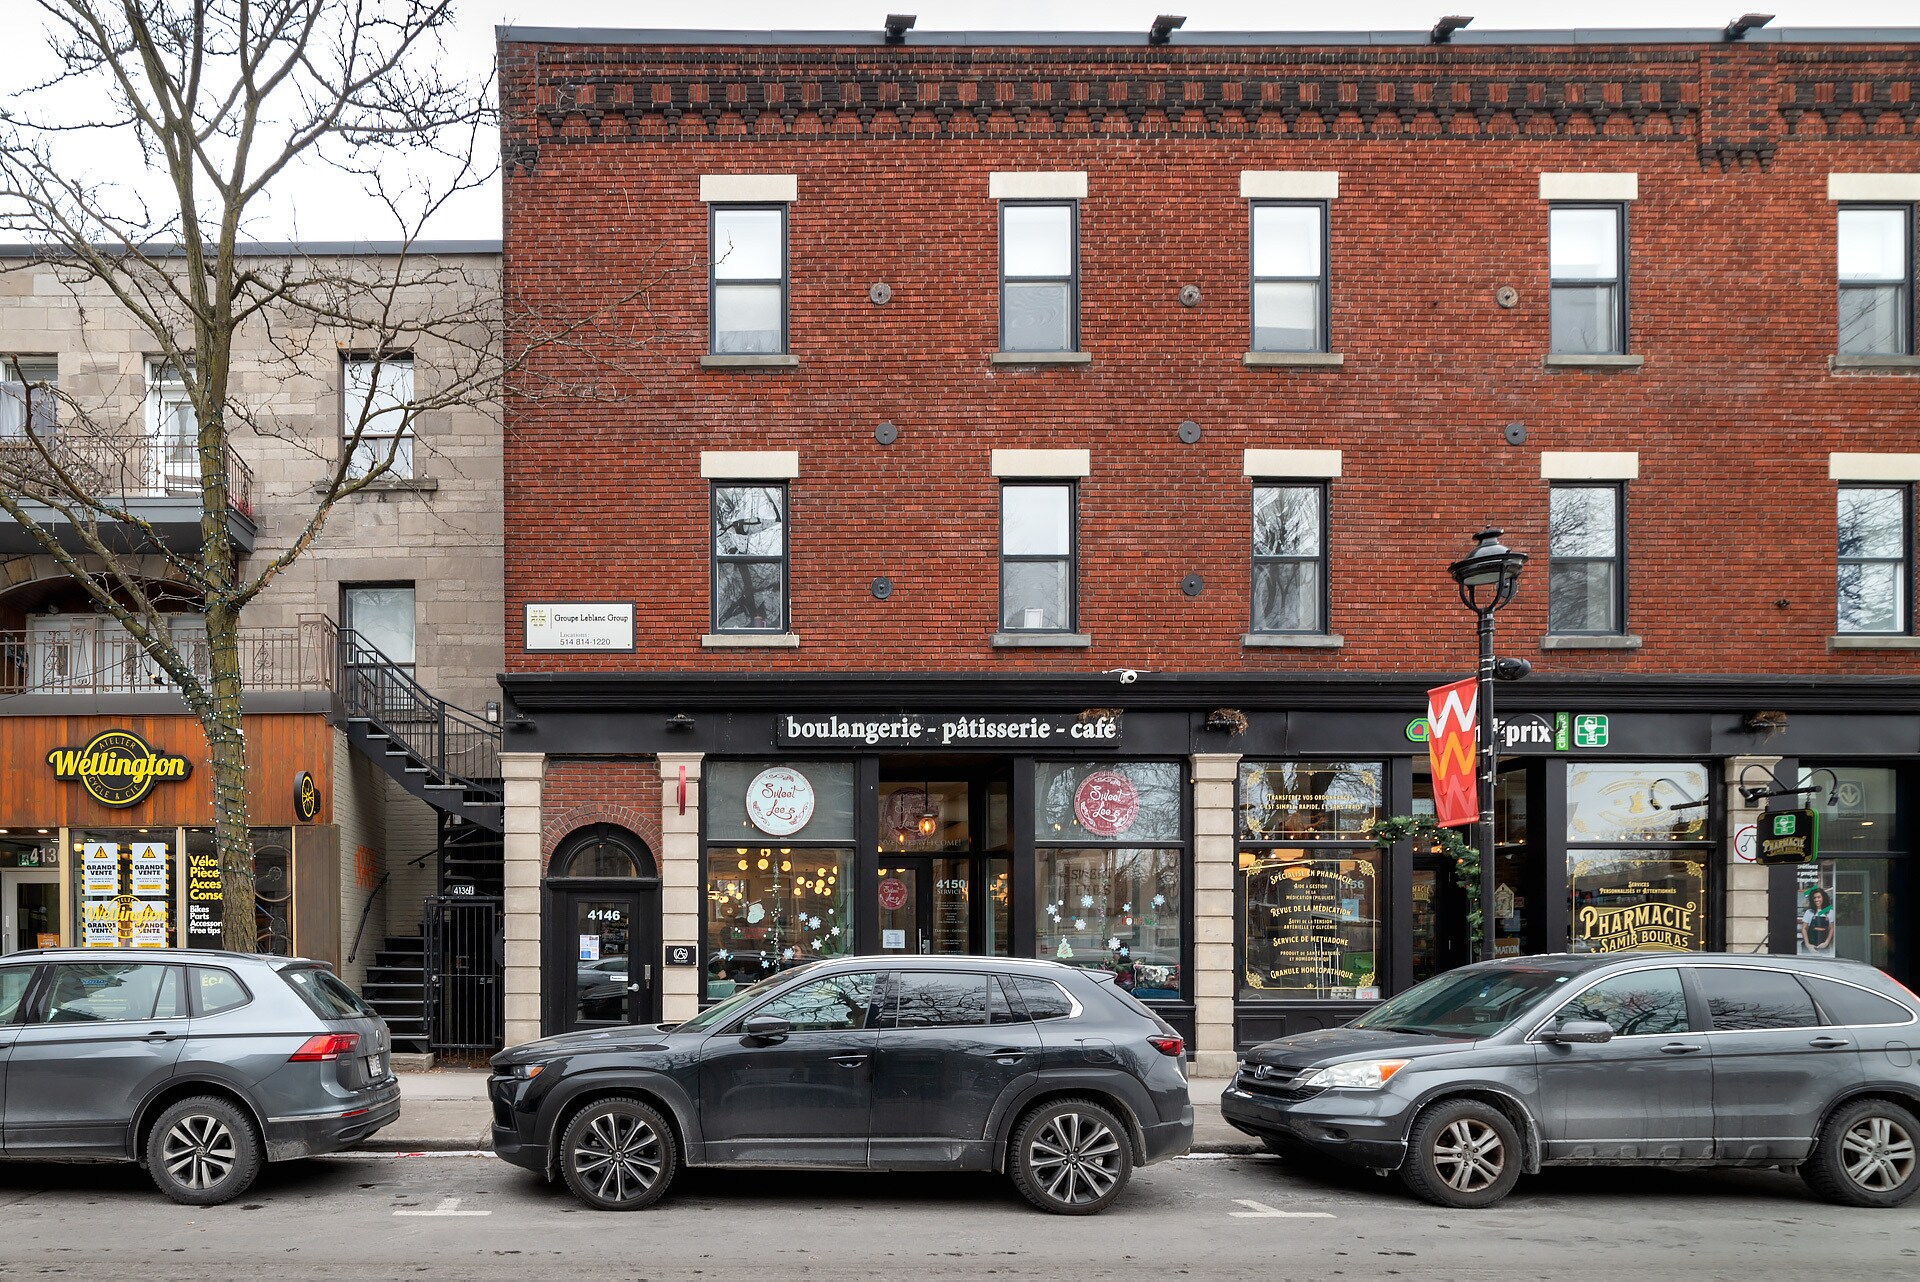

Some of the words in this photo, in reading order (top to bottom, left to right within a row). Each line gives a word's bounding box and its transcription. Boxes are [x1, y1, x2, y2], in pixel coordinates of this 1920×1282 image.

[554, 614, 579, 623] Groupe
[580, 613, 606, 623] Leblanc
[607, 614, 629, 623] Group
[560, 638, 578, 646] 514
[580, 638, 611, 646] 814-1220
[787, 715, 922, 744] boulangerie
[941, 716, 1050, 744] pâtisserie
[1070, 716, 1117, 739] café
[99, 737, 136, 750] ATELIER
[48, 750, 185, 784] Wellington
[88, 777, 110, 799] CYCLE
[125, 784, 141, 798] CIE
[761, 783, 804, 799] Sweet
[1090, 784, 1130, 801] Sweet
[190, 866, 219, 878] Pièce
[1316, 870, 1352, 885] PHARMACIE
[189, 877, 222, 889] Acces
[936, 879, 966, 889] 4150
[1340, 880, 1365, 889] 156
[190, 888, 223, 900] Conse
[190, 905, 209, 913] Bikes
[587, 909, 621, 920] 4146
[1270, 906, 1292, 917] REVUE
[1312, 903, 1353, 916] MÉDICATION
[85, 905, 168, 926] Wellington
[190, 912, 210, 920] Parts
[1579, 905, 1692, 940] PHARMACIE
[190, 926, 206, 934] Free
[207, 926, 221, 936] tips
[1272, 936, 1299, 947] SERVICE
[1301, 935, 1309, 943] DE
[1310, 935, 1349, 946] METHADONE
[1599, 933, 1639, 953] SAMIR
[1641, 930, 1689, 947] BOURAS
[1270, 967, 1299, 979] GRANULE
